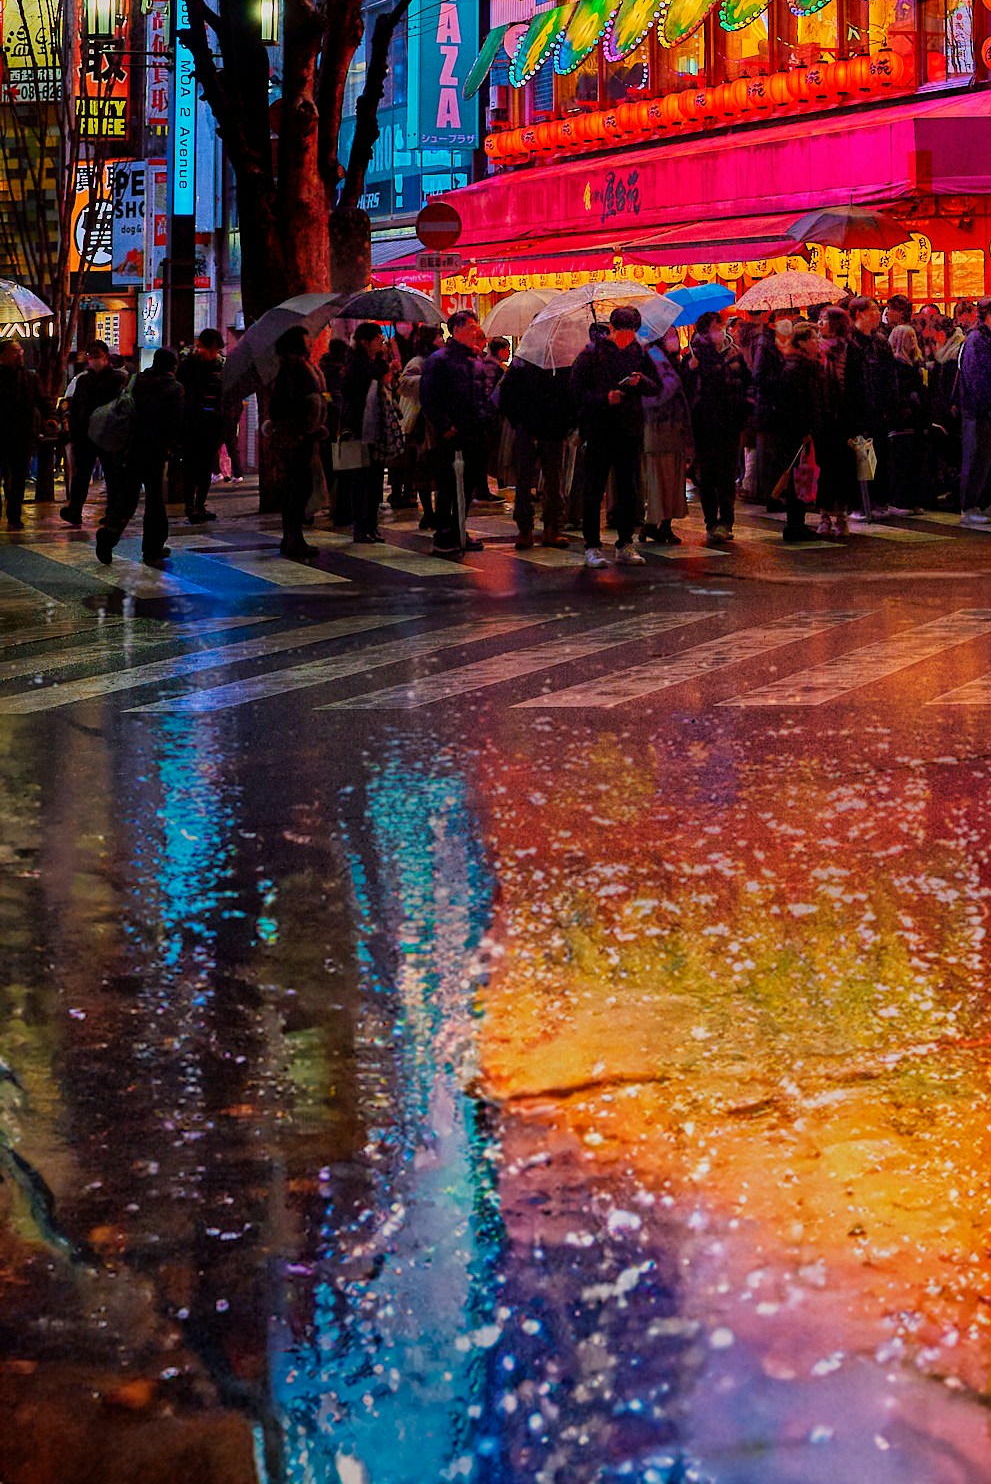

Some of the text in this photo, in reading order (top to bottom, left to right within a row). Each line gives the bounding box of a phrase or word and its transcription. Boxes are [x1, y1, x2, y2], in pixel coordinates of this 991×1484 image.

[180, 59, 192, 97] MOA
[180, 107, 191, 117] 2
[420, 133, 476, 145] シュープラザ
[178, 126, 191, 189] Avenue
[113, 169, 145, 197] PE
